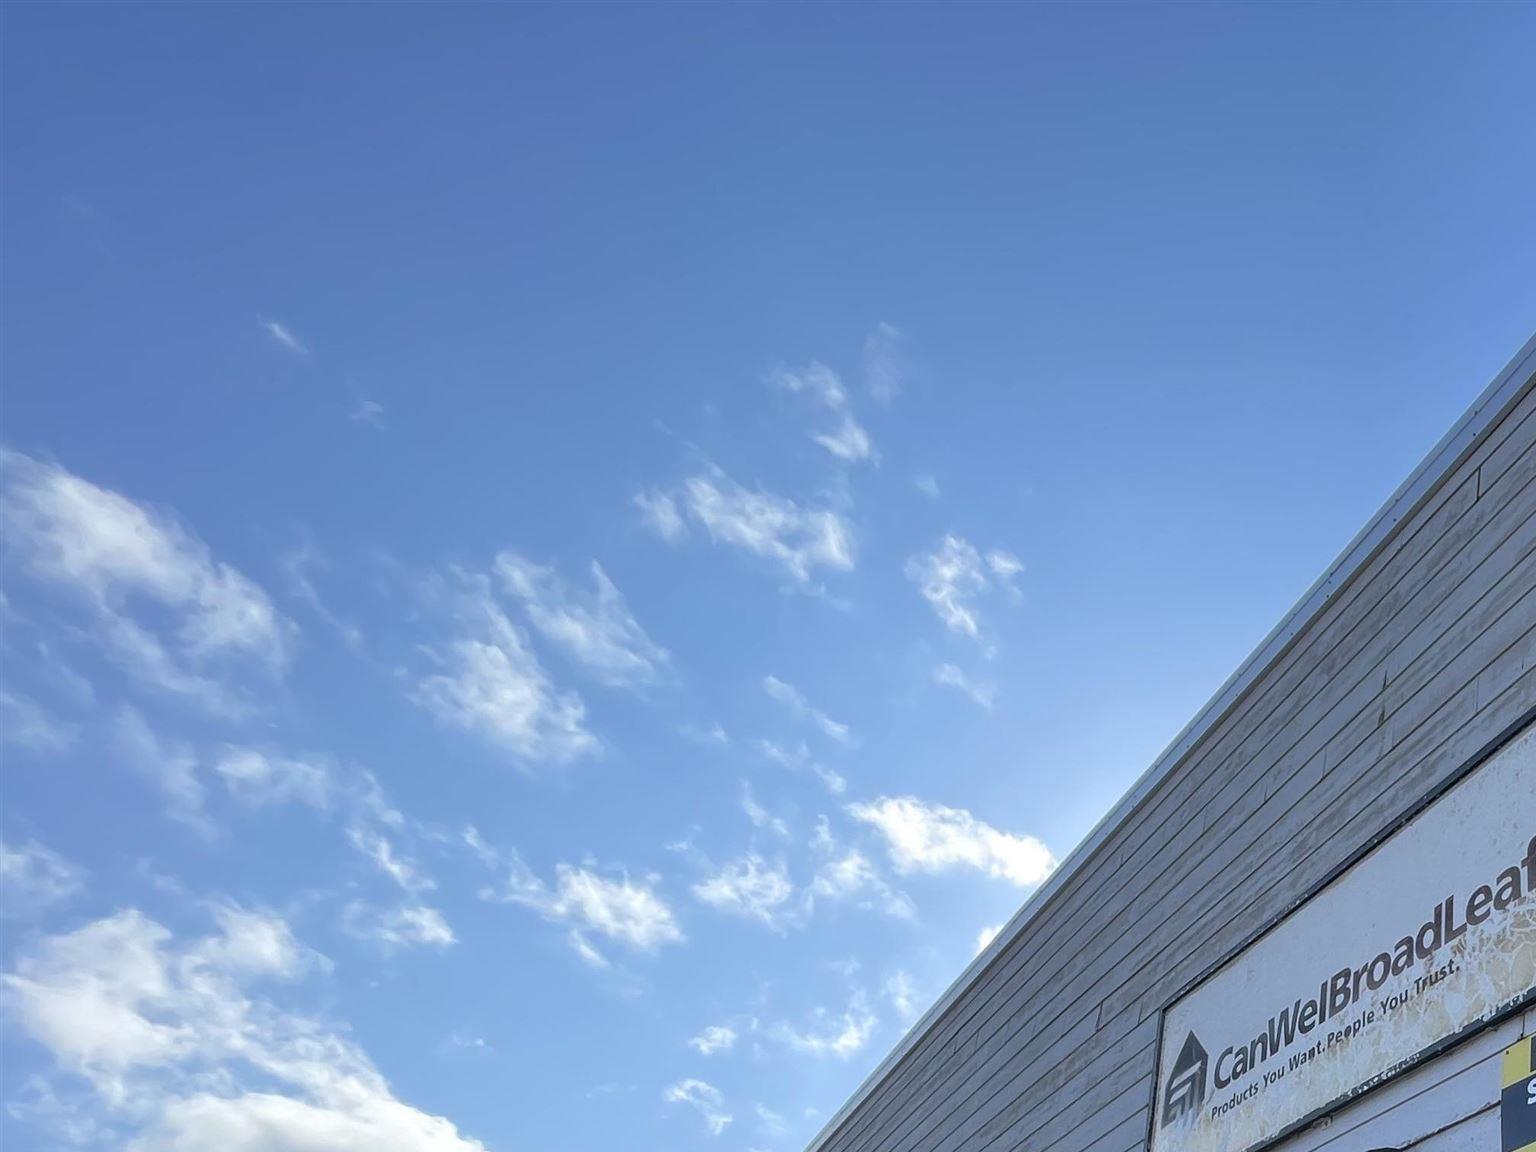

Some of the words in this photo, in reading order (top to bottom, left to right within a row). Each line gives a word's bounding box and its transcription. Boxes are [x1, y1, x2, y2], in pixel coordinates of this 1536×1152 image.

[1211, 1079, 1259, 1120] Products
[1262, 1064, 1285, 1089] You
[1326, 1011, 1375, 1049] People
[1379, 989, 1409, 1015] You
[1413, 961, 1461, 997] Trust.
